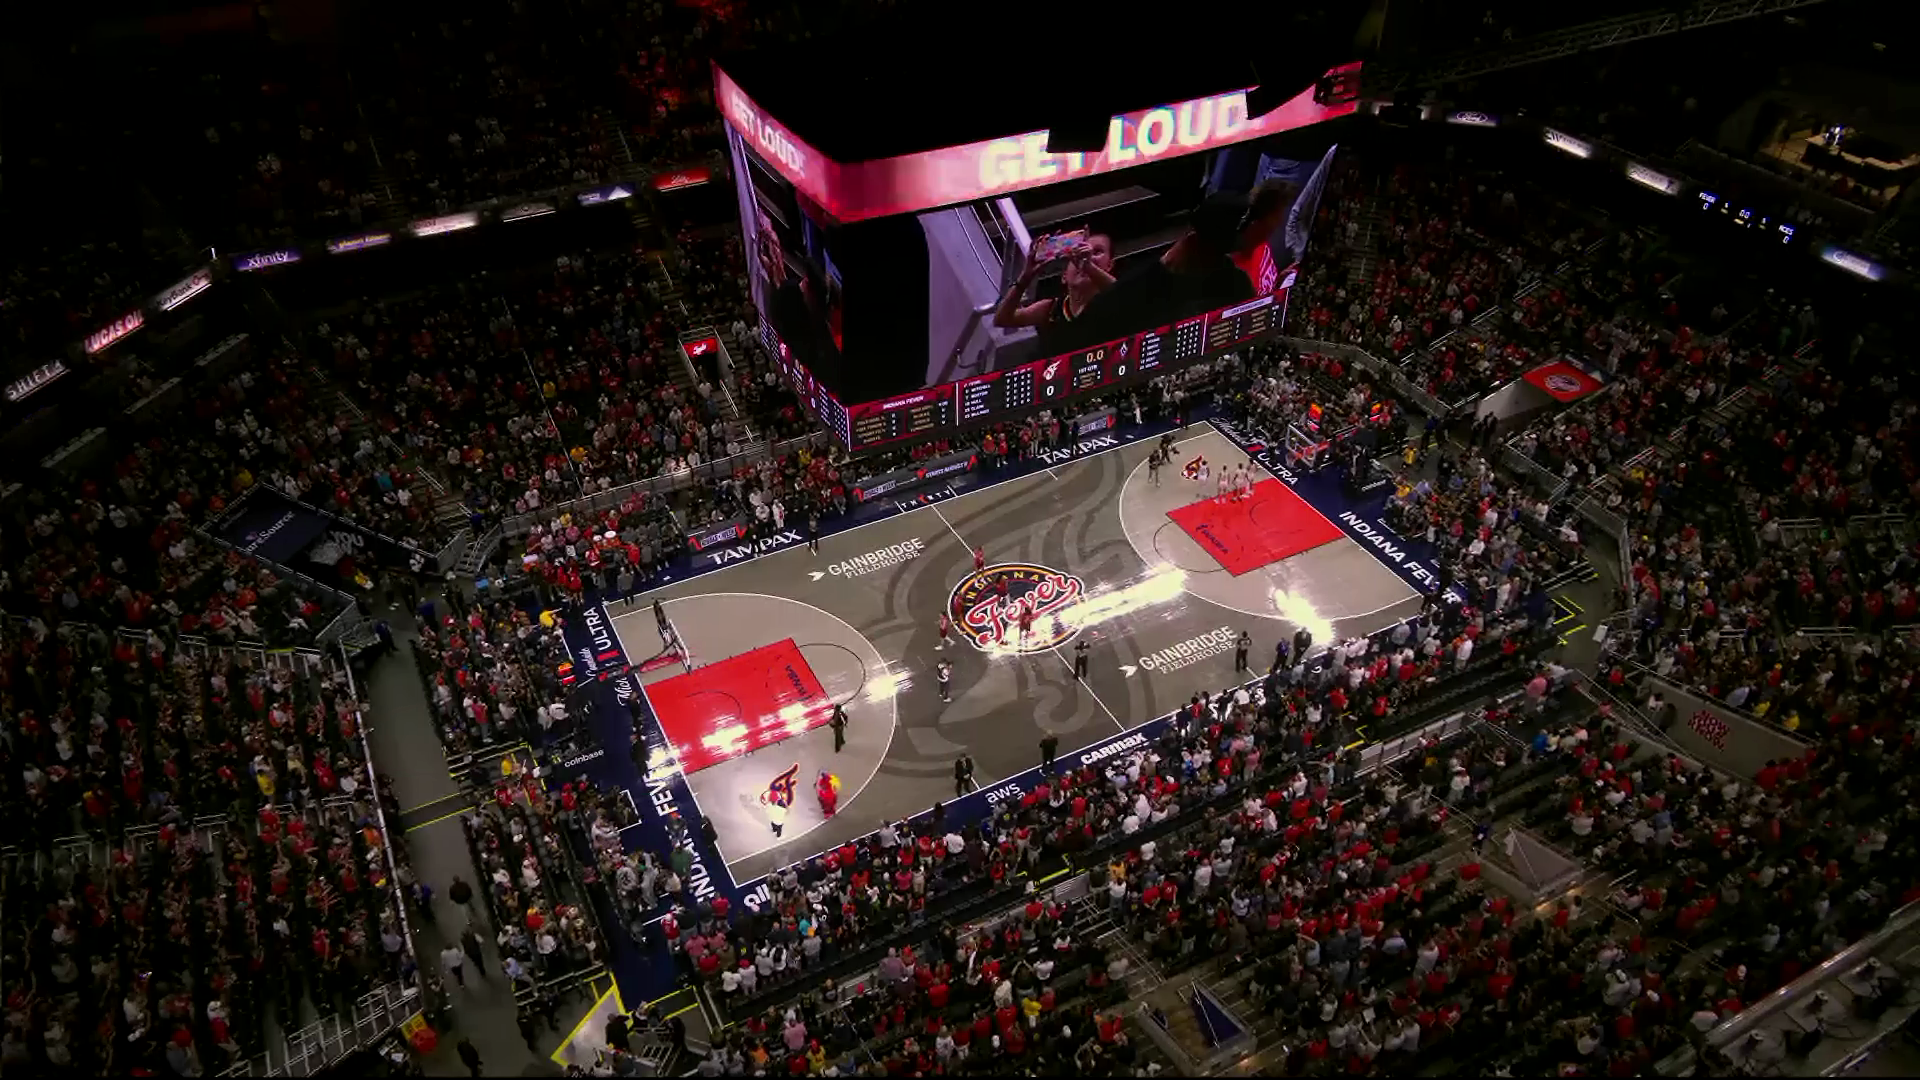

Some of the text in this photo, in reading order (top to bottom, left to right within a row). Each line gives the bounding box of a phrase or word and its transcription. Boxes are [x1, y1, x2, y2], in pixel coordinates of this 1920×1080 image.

[247, 250, 290, 267] xfinity
[84, 308, 145, 352] LUCAS OIL
[1086, 350, 1104, 364] 0.0
[1119, 365, 1127, 376] 0
[1046, 386, 1055, 397] 0
[1037, 434, 1119, 464] TAMPAX
[1257, 452, 1299, 485] ULTRA
[707, 529, 803, 565] TAMPAX
[828, 537, 926, 576] GAINBRIDGE
[1339, 511, 1463, 605] INDIANA FEVR
[844, 550, 921, 579] FIELDHOUSE
[964, 574, 1080, 648] Fever
[583, 606, 612, 651] ULTRA
[1139, 625, 1238, 672] GAINBRIDGE
[1161, 640, 1238, 675] FIELDHOUSE
[564, 749, 605, 768] coinbase
[985, 782, 1021, 803] aws
